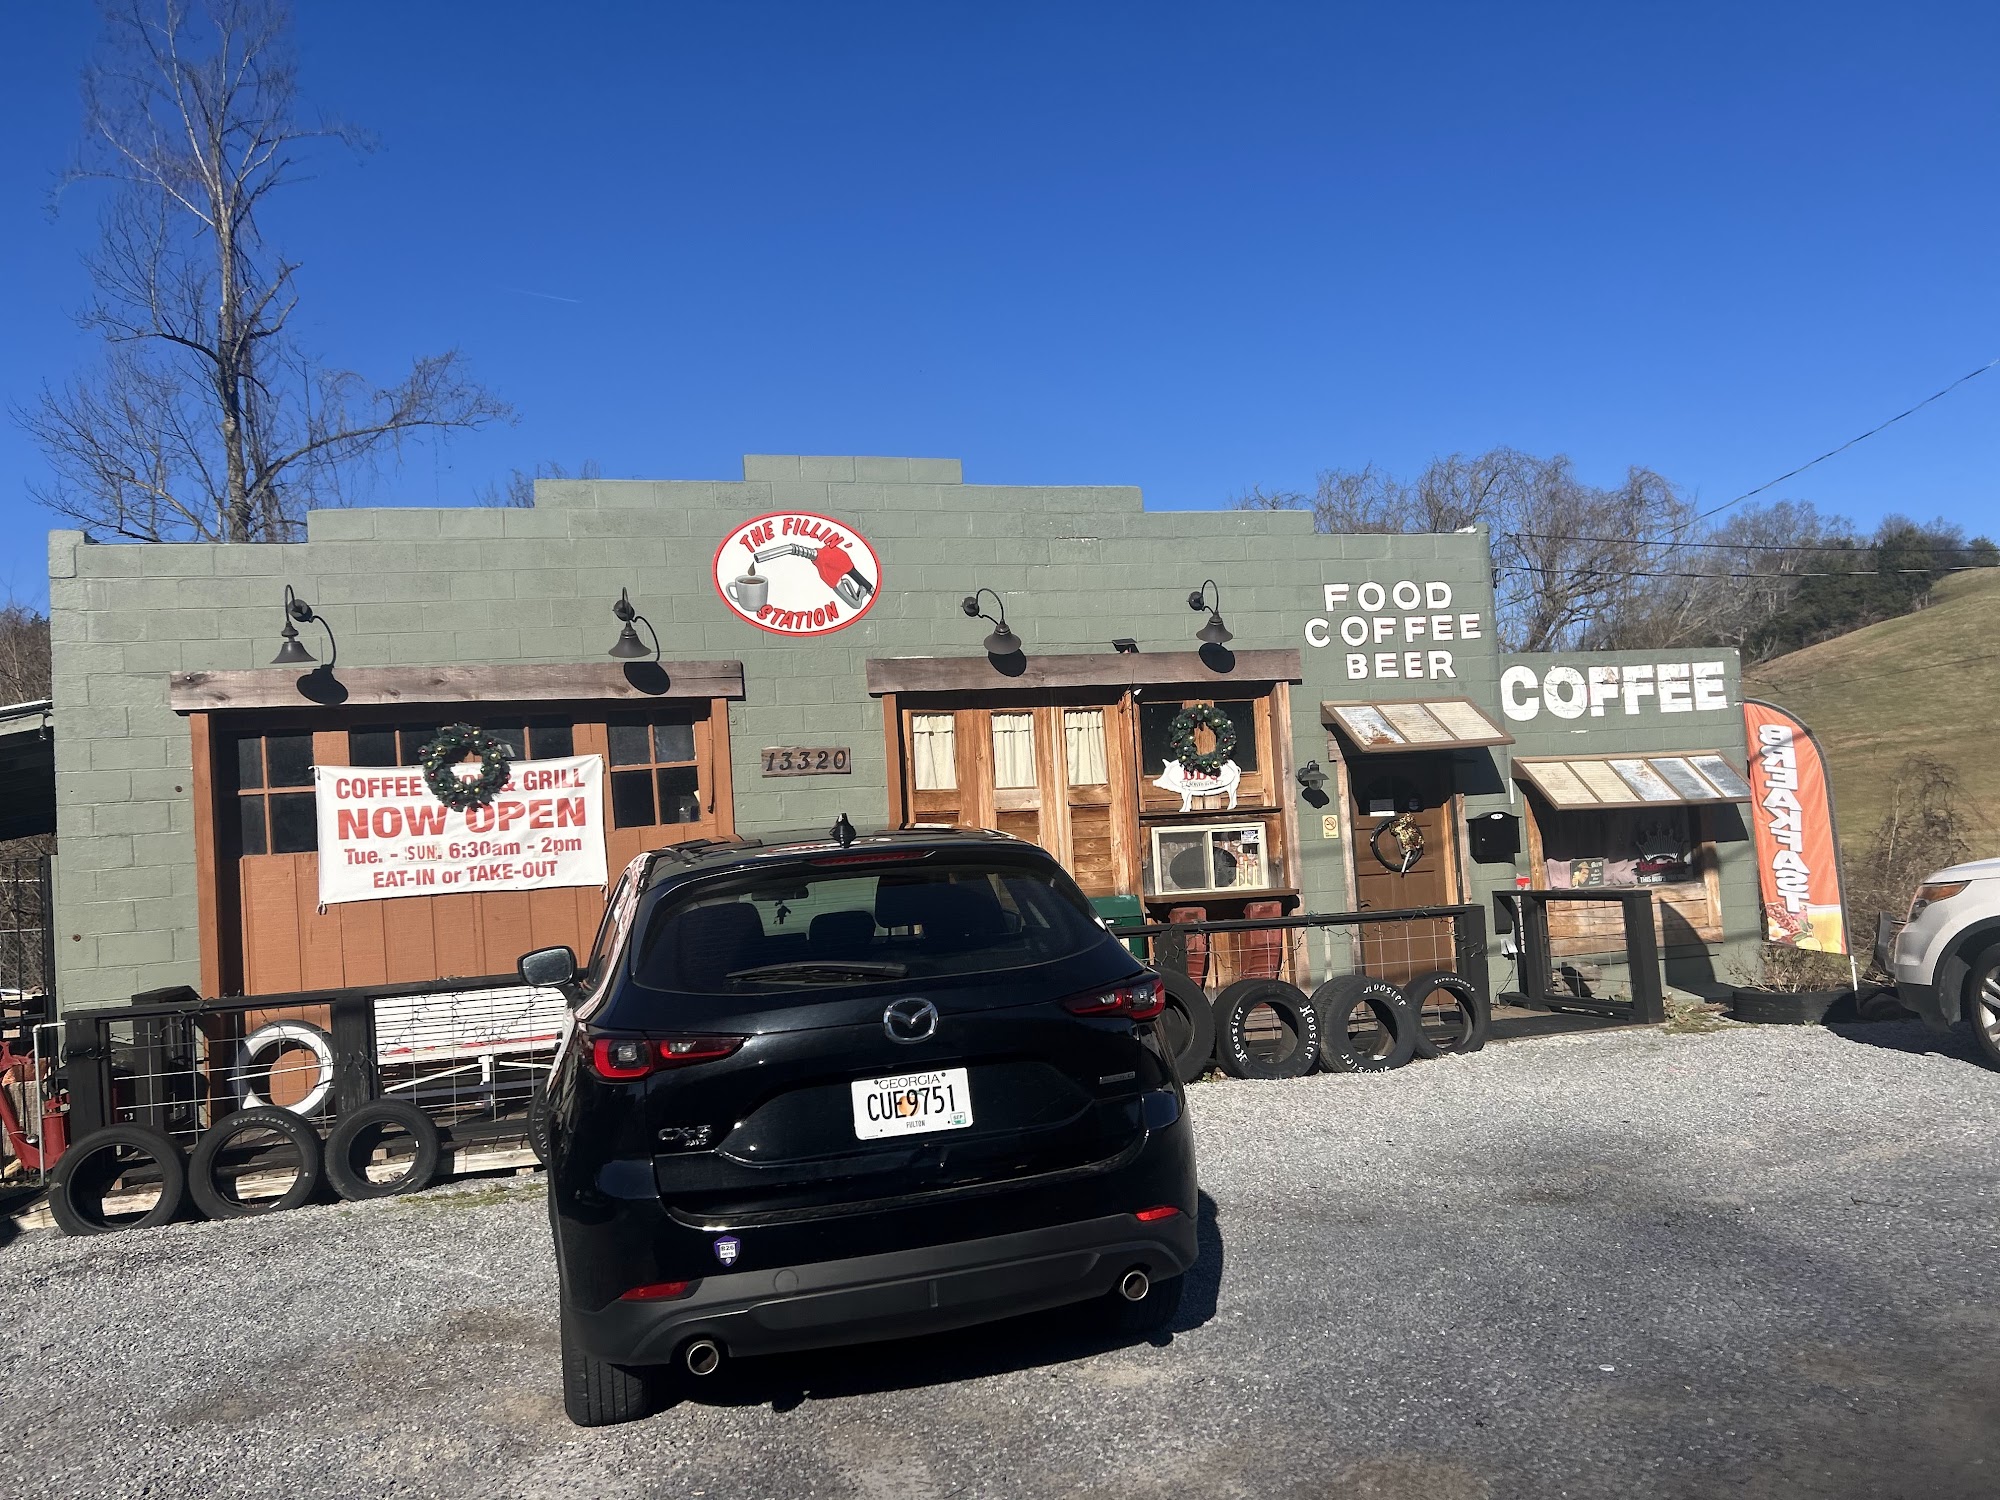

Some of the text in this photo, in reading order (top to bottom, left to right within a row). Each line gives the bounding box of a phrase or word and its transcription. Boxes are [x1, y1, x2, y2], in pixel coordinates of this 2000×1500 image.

[739, 517, 853, 553] THE FILLIN'
[1323, 581, 1453, 612] FOOD
[757, 601, 839, 629] STATION
[1304, 613, 1482, 648] COFFEE
[1346, 650, 1457, 680] BEER
[1501, 661, 1728, 721] COFFEE
[766, 750, 847, 771] 13320
[335, 776, 423, 799] COFFEE
[523, 768, 586, 791] GRILL
[337, 796, 587, 840] NOW OPEN
[344, 847, 383, 865] Tue.
[449, 841, 521, 859] 6:30am
[541, 836, 582, 855] 2pm
[373, 860, 558, 888] EAT-IN or TAKE-OUT
[1230, 1006, 1248, 1062] Hoosier
[1299, 1004, 1319, 1060] Hoosier
[879, 1073, 940, 1090] GEORGIA
[867, 1084, 956, 1121] CUE9751
[906, 1119, 926, 1129] FULTON
